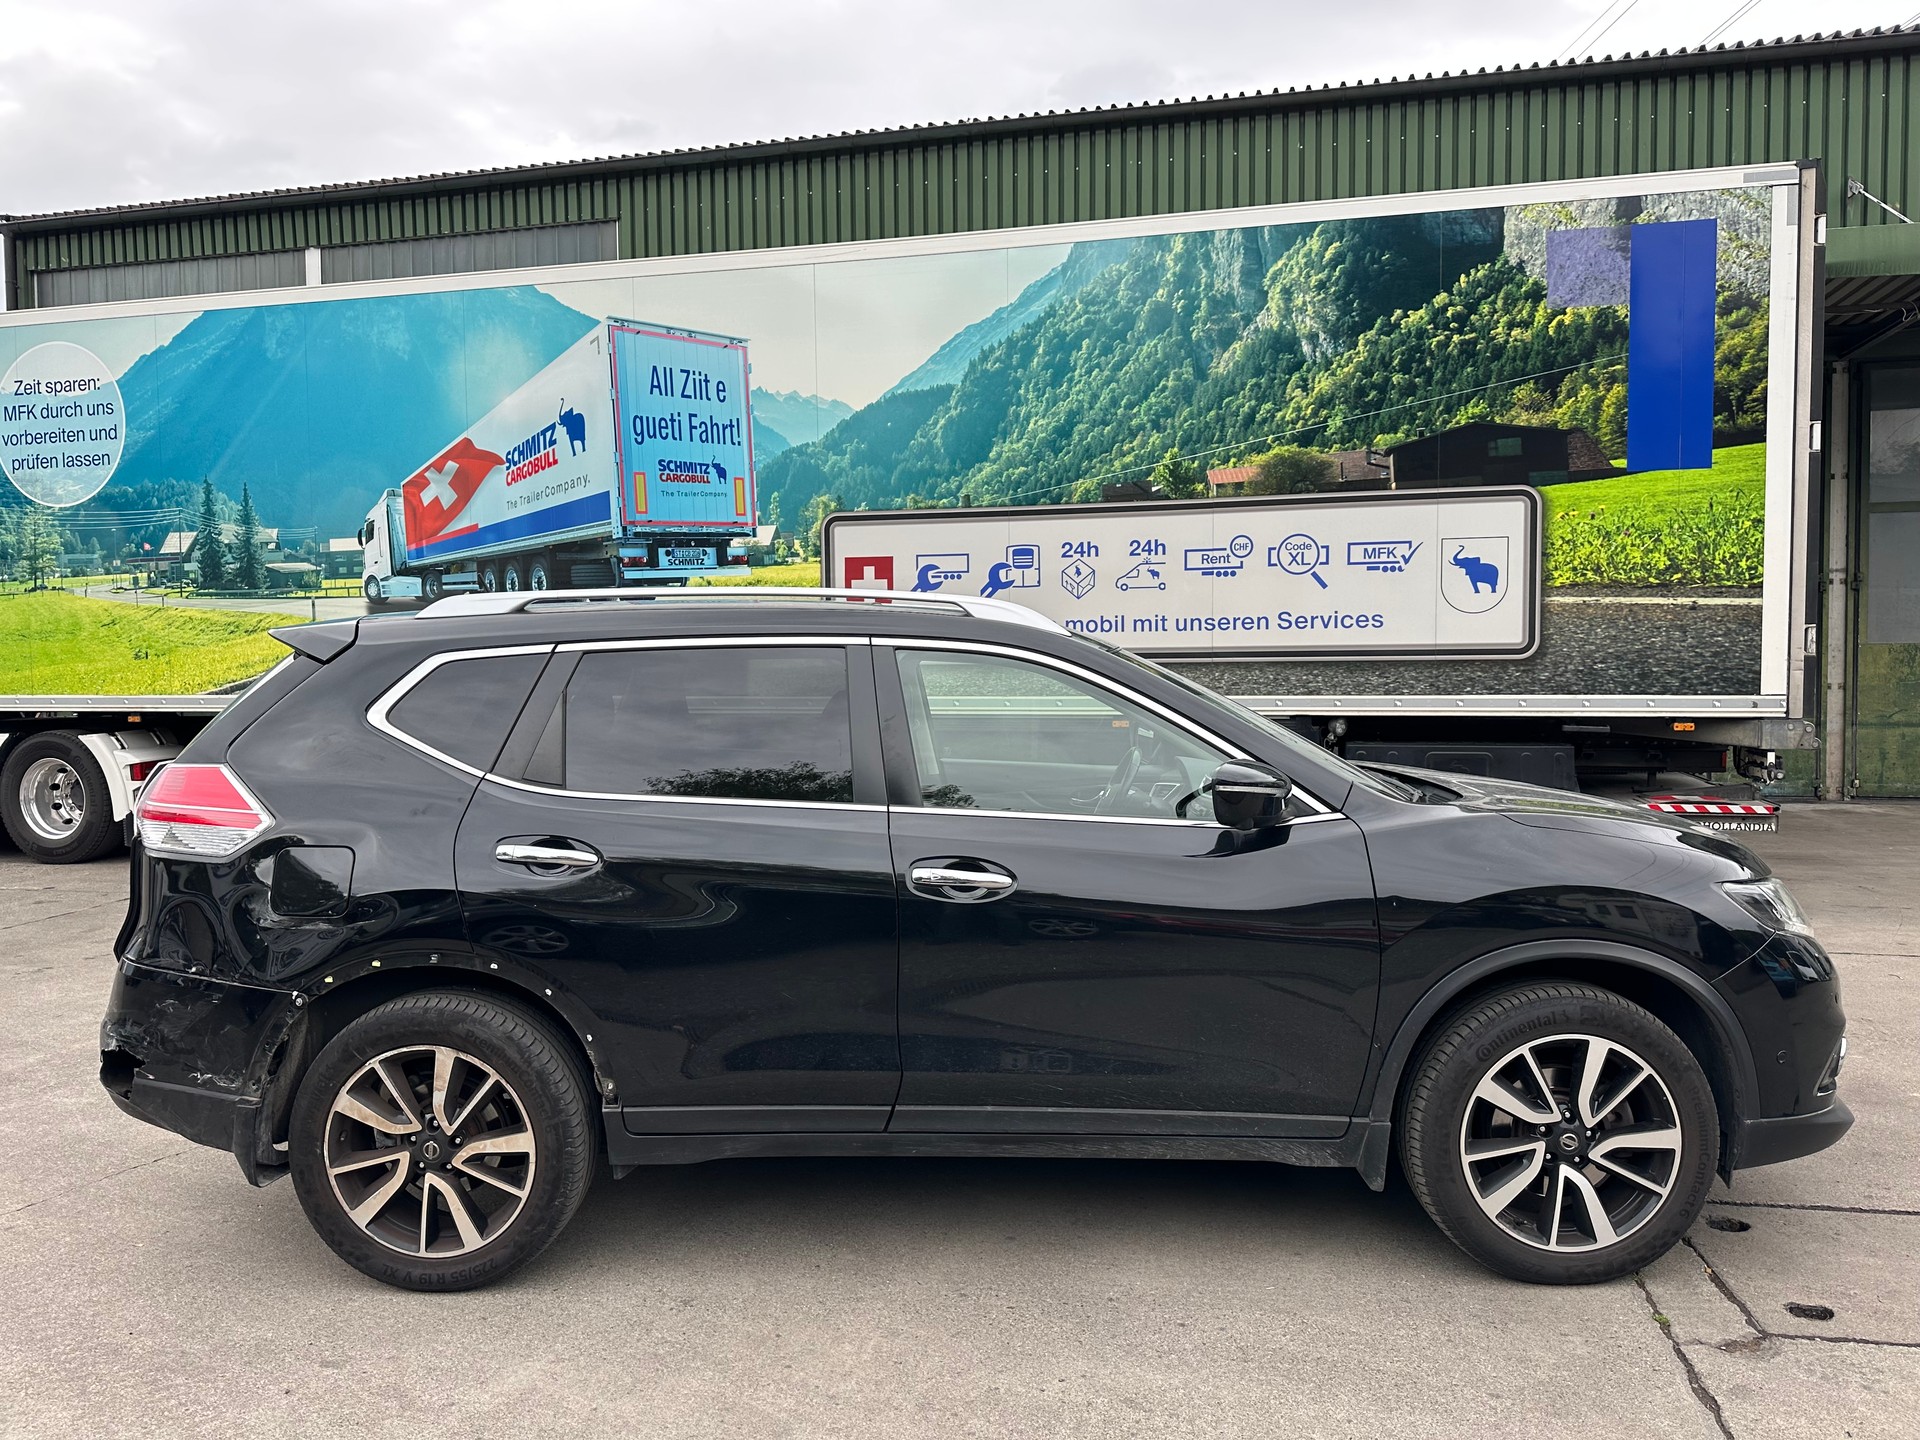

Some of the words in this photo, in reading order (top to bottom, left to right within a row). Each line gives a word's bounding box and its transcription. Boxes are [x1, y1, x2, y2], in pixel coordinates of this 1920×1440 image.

[13, 378, 42, 397] Zeit
[44, 377, 101, 397] sparen:
[649, 365, 675, 398] All
[679, 368, 712, 401] Ziit
[716, 380, 727, 403] e
[3, 404, 38, 422] MFK
[40, 401, 83, 419] durch
[86, 402, 115, 417] uns
[1, 426, 86, 447] vorbereiten
[89, 424, 118, 441] und
[632, 411, 683, 446] gueti
[688, 412, 742, 447] Fahrt!
[505, 421, 558, 471] SCHMITZ
[11, 453, 59, 474] prüfen
[62, 452, 111, 468] lassen
[506, 448, 559, 487] CARGOBULL
[657, 458, 711, 475] SCHMITZ
[658, 472, 711, 485] CARGOBULL
[506, 500, 518, 511] The
[1061, 541, 1100, 558] 24h
[1129, 539, 1167, 556] 24h
[1233, 542, 1250, 552] CHF
[1284, 541, 1313, 551] Code
[1363, 546, 1398, 560] MFK
[667, 558, 706, 566] SCHMITZ
[1201, 553, 1231, 565] Rent
[1287, 551, 1312, 567] XL
[1065, 614, 1125, 633] mobil
[1132, 614, 1168, 632] mit
[1175, 615, 1270, 632] unseren
[1277, 610, 1384, 630] Services
[1697, 821, 1776, 832] HOLLANDIA
[1474, 1010, 1558, 1063] Continental
[381, 1262, 400, 1281] XL
[402, 1270, 413, 1283] V
[418, 1272, 434, 1285] 19
[436, 1272, 446, 1284] R
[450, 1257, 498, 1284] 225/55
